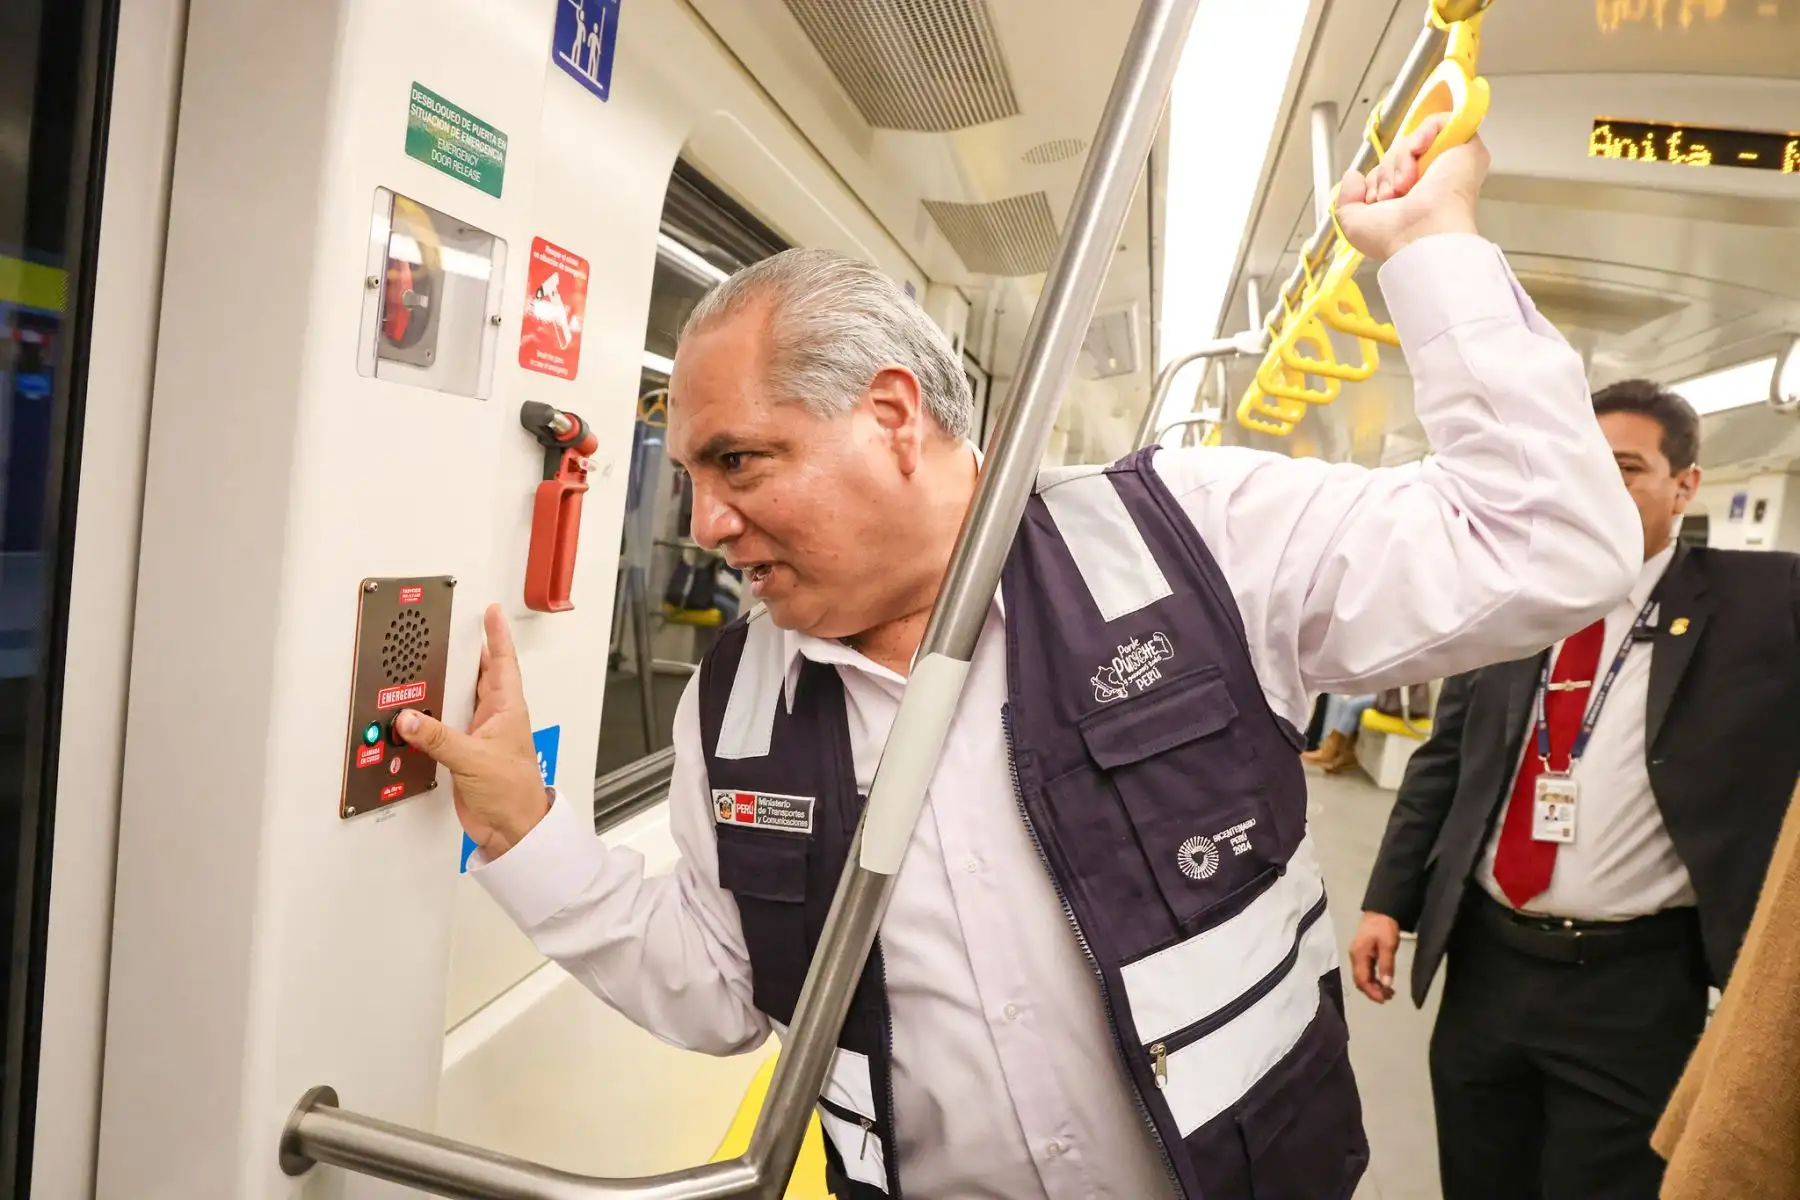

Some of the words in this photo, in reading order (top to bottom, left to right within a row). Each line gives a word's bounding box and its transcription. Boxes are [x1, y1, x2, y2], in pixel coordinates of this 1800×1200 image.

[412, 89, 461, 124] DESBLOQUEO
[462, 119, 472, 131] DE
[472, 123, 497, 144] PUERTA
[497, 137, 506, 150] EN
[437, 137, 480, 167] EMERGENCY
[450, 126, 461, 139] DE
[461, 131, 503, 163] EMERGENCIA
[1588, 124, 1712, 167] Anita
[431, 149, 452, 169] DOOR
[452, 160, 481, 183] RELEASE
[381, 686, 422, 705] EMERGENCIA
[736, 801, 754, 815] PERÚ
[758, 806, 766, 815] de
[768, 808, 805, 819] Transportes
[759, 797, 791, 809] Ministerio
[757, 816, 761, 824] y
[763, 815, 808, 828] Comunicaciones
[1212, 818, 1256, 843] BICENTENARIO
[1232, 840, 1252, 856] 2024
